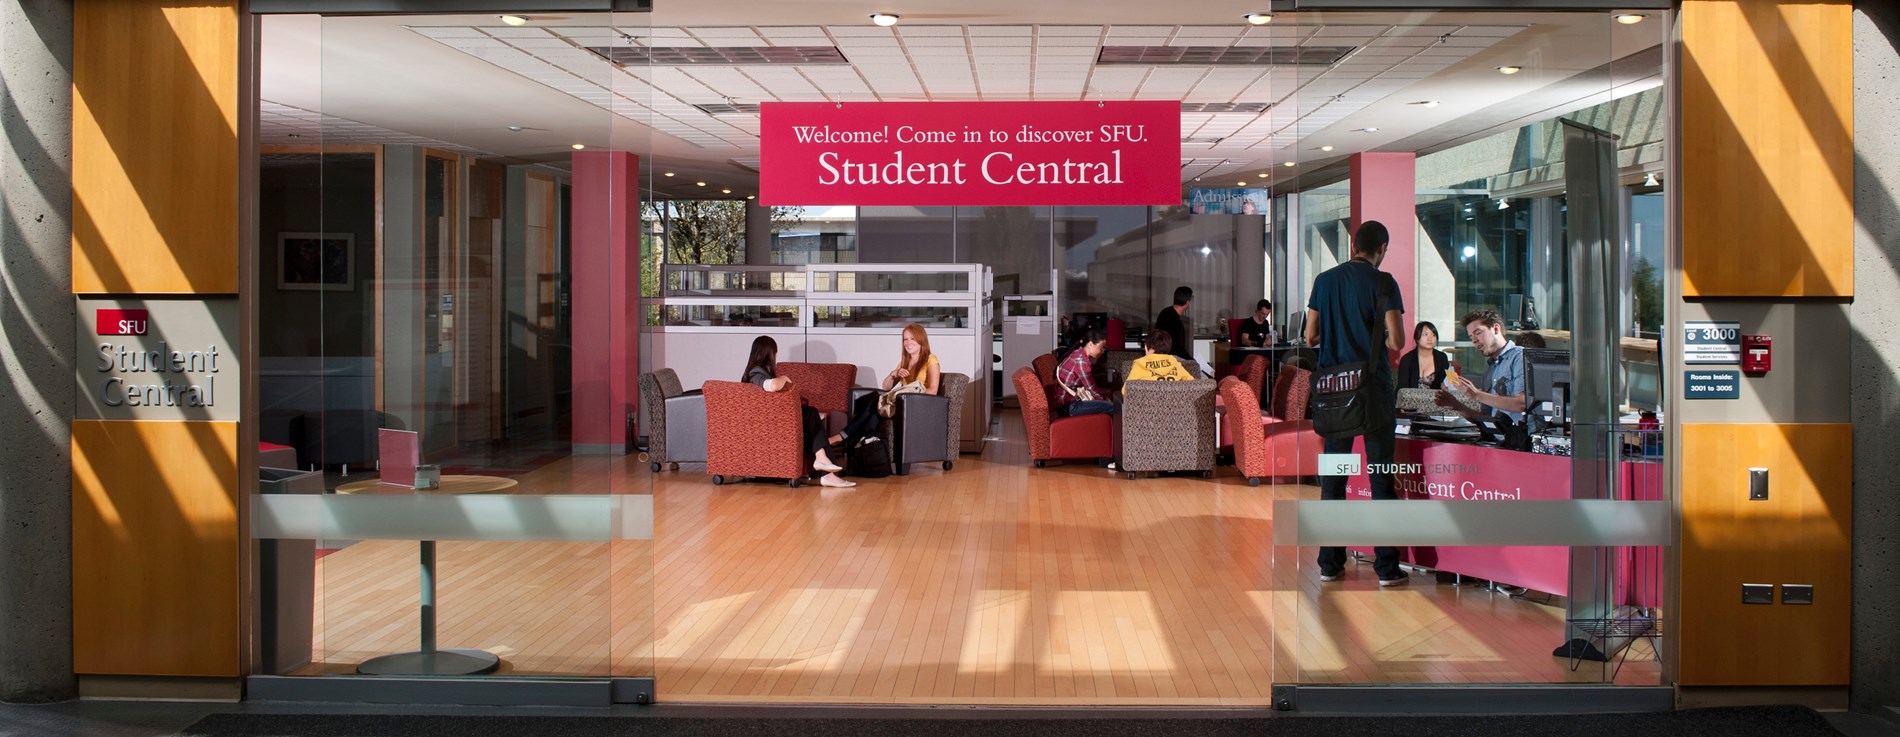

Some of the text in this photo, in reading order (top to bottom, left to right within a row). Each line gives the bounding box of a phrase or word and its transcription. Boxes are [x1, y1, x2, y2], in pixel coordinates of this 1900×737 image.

[792, 125, 1149, 143] Welcome! Come in to discover SFU.
[818, 150, 1124, 185] Student Central
[118, 319, 147, 334] SFU
[1702, 328, 1736, 340] 3000
[97, 341, 218, 372] Student
[99, 375, 214, 406] Central
[1336, 464, 1482, 474] SFU STUDENT CENTRAL
[1394, 475, 1455, 498] Student
